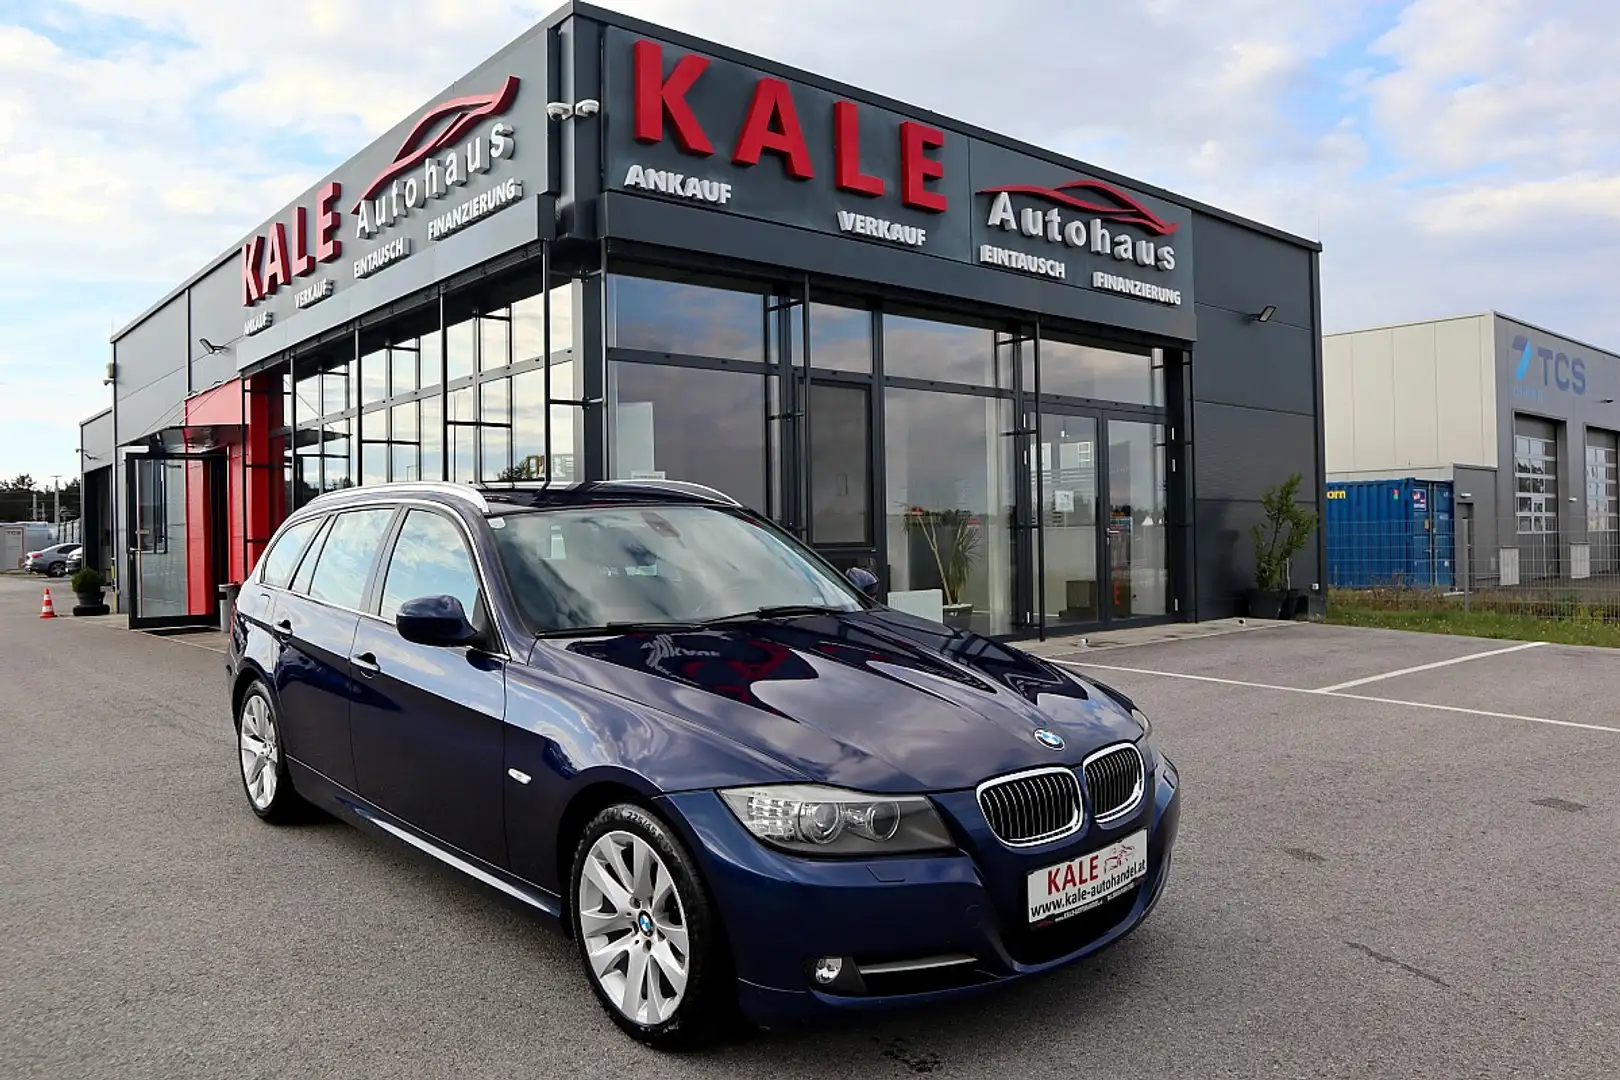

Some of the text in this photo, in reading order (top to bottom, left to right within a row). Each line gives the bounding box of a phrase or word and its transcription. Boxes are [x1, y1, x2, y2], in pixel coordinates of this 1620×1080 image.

[633, 39, 948, 213] KALE
[356, 122, 514, 239] Autohaus
[427, 177, 523, 241] FINANZIERUNG
[623, 164, 926, 246] ANKAUF VERKAUF
[241, 182, 342, 307] KALE
[353, 236, 411, 279] EINTAUSCH
[987, 191, 1176, 271] Autohaus
[293, 277, 334, 309] VERKAUF
[980, 244, 1182, 306] EINTAUSCH FINANZIERUNG
[1537, 346, 1587, 396] TCS
[627, 811, 657, 836] 225/45
[1031, 859, 1146, 918] www.kale-autohandel.at
[1047, 855, 1099, 896] KALE
